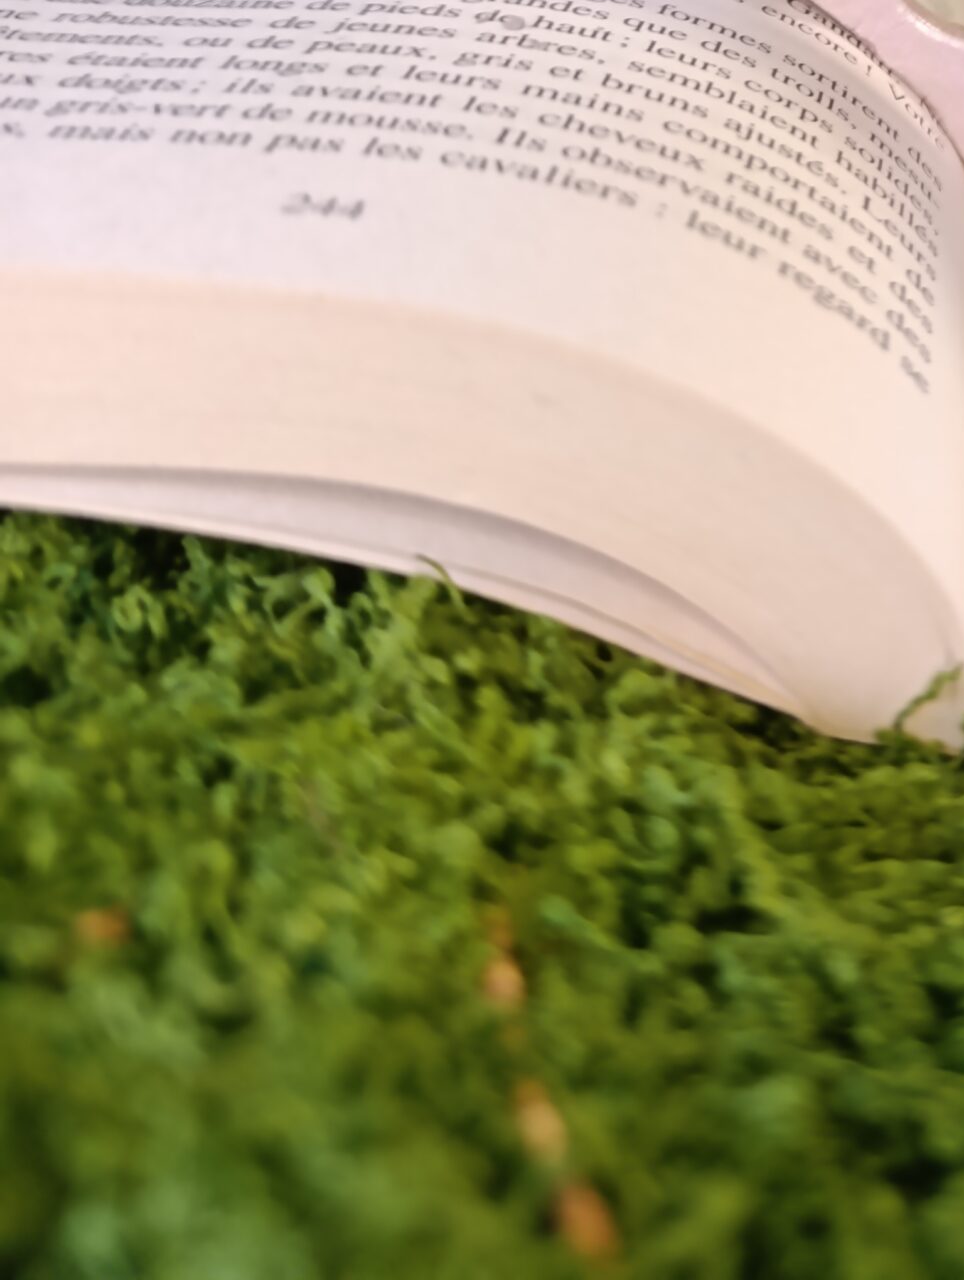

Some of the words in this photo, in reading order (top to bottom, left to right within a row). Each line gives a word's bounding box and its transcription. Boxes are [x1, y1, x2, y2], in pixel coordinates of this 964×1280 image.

[50, 11, 254, 28] robustesse
[267, 16, 317, 29] de
[322, 19, 459, 38] jeunes
[475, 31, 606, 66] arbres,
[627, 60, 820, 149] semblaient
[835, 149, 939, 257] habillés
[356, 1, 463, 18] pieds
[532, 15, 614, 42] haut
[646, 40, 733, 80] leurs
[743, 78, 834, 134] corps
[844, 136, 939, 236] solides,
[623, 17, 689, 42] que
[700, 39, 757, 69] des
[770, 67, 859, 130] trolls,
[656, 3, 772, 54] formes
[782, 54, 901, 141] sortirent
[906, 146, 944, 193] des
[761, 5, 859, 65] encore
[47, 122, 155, 142] mais
[168, 128, 254, 147] non
[262, 133, 345, 155] pas
[362, 136, 424, 161] les
[439, 150, 638, 208] cavaliers
[685, 209, 767, 261] leur
[777, 261, 891, 353] regard
[902, 354, 930, 395] se
[57, 72, 187, 95] doigts
[221, 78, 275, 94] ils
[290, 85, 443, 109] avaient
[463, 96, 519, 120] les
[537, 113, 706, 172] cheveux
[724, 171, 835, 241] raides
[847, 246, 876, 275] et
[890, 281, 934, 335] des
[66, 51, 206, 69] étaient
[218, 55, 329, 77] longs
[345, 64, 388, 77] et
[400, 65, 503, 91] leurs
[521, 84, 645, 123] mains
[662, 120, 894, 263] comportaient
[905, 268, 936, 308] de
[182, 37, 233, 48] ou
[246, 35, 296, 49] de
[452, 50, 535, 72] gris
[549, 66, 586, 81] et
[601, 73, 711, 120] bruns
[723, 117, 848, 196] ajustés.
[861, 194, 937, 282] Leurs
[240, 103, 293, 121] de
[306, 109, 474, 141] mousse.
[495, 126, 548, 153] Ils
[560, 146, 791, 246] observaient
[802, 243, 880, 304] avec
[886, 309, 932, 364] des
